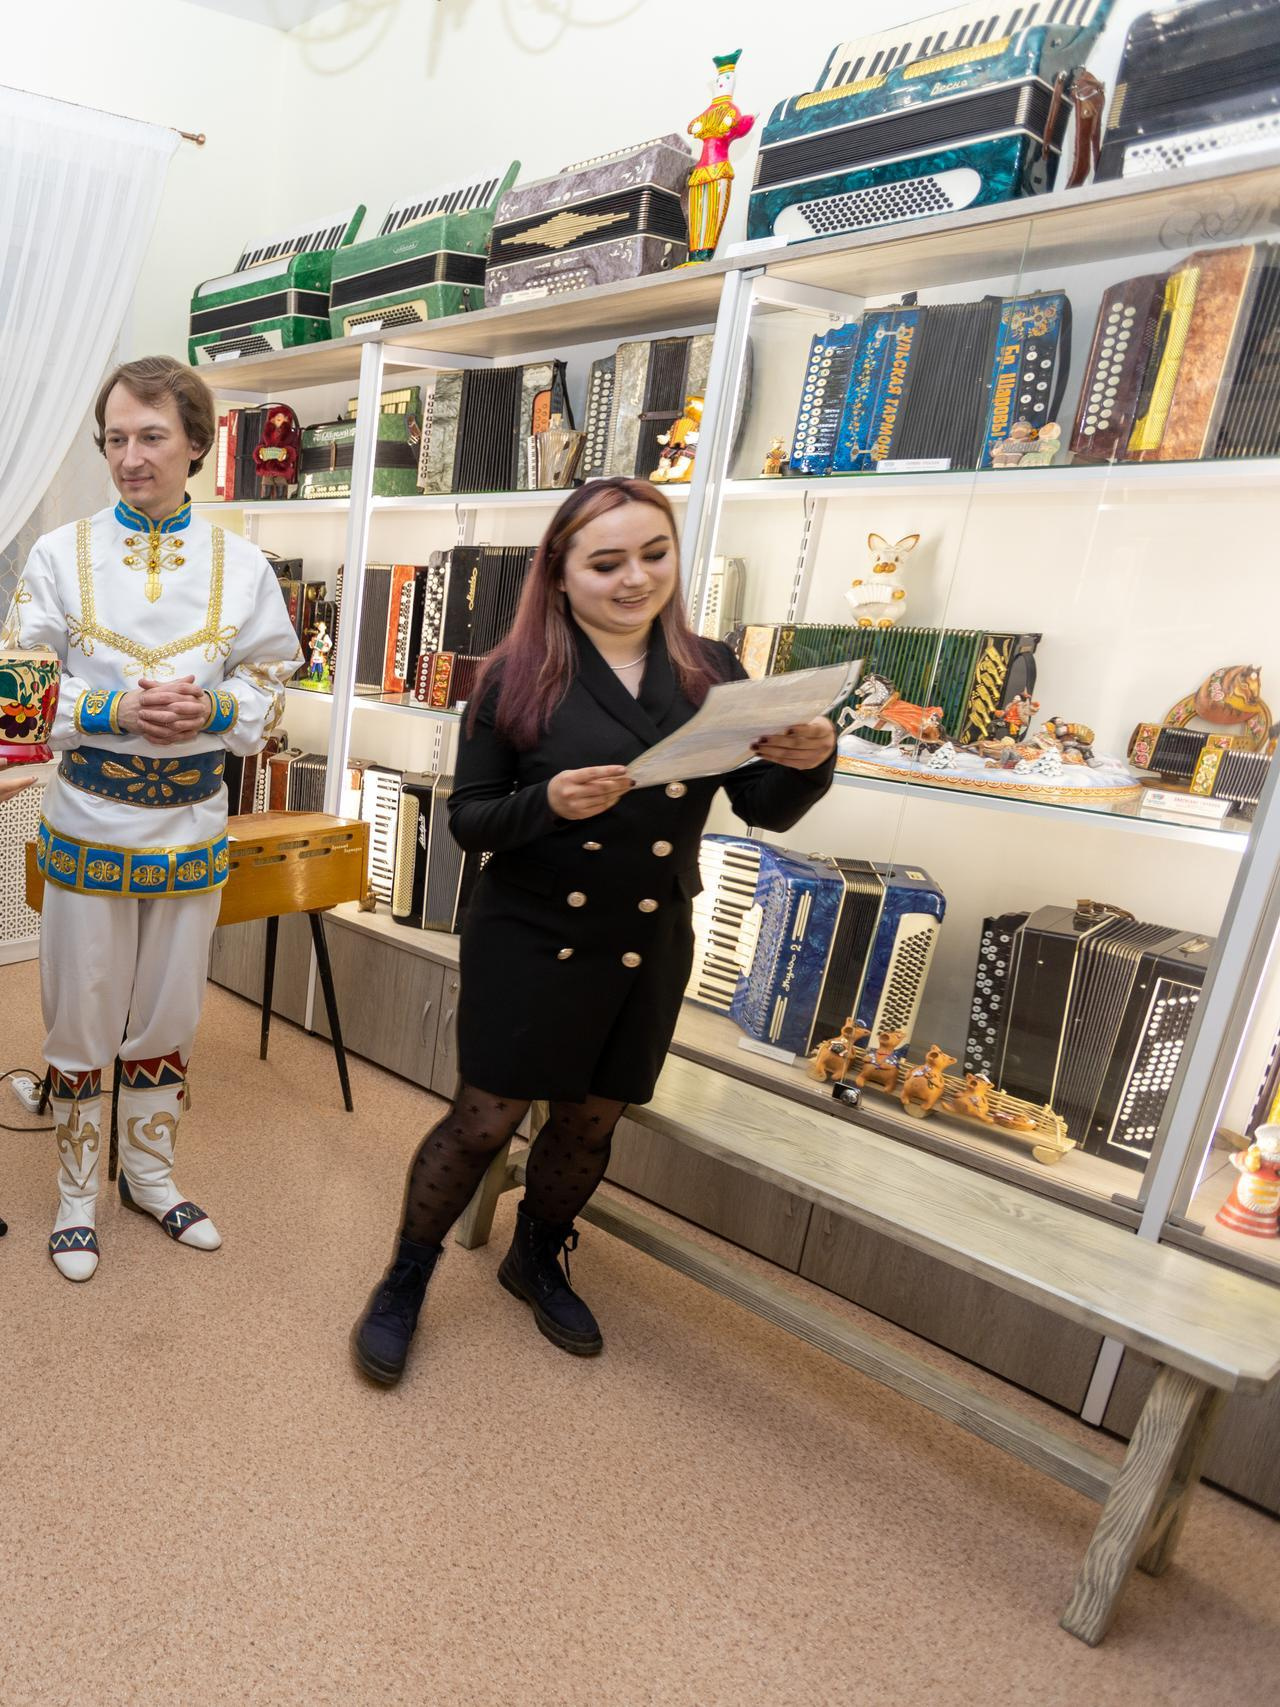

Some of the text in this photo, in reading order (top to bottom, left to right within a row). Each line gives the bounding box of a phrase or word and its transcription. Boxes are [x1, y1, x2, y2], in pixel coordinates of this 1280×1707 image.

[874, 326, 914, 460] ТУЛЬСКАЯ ГАРМОНЬ
[992, 344, 1020, 436] Бр. Шаровы
